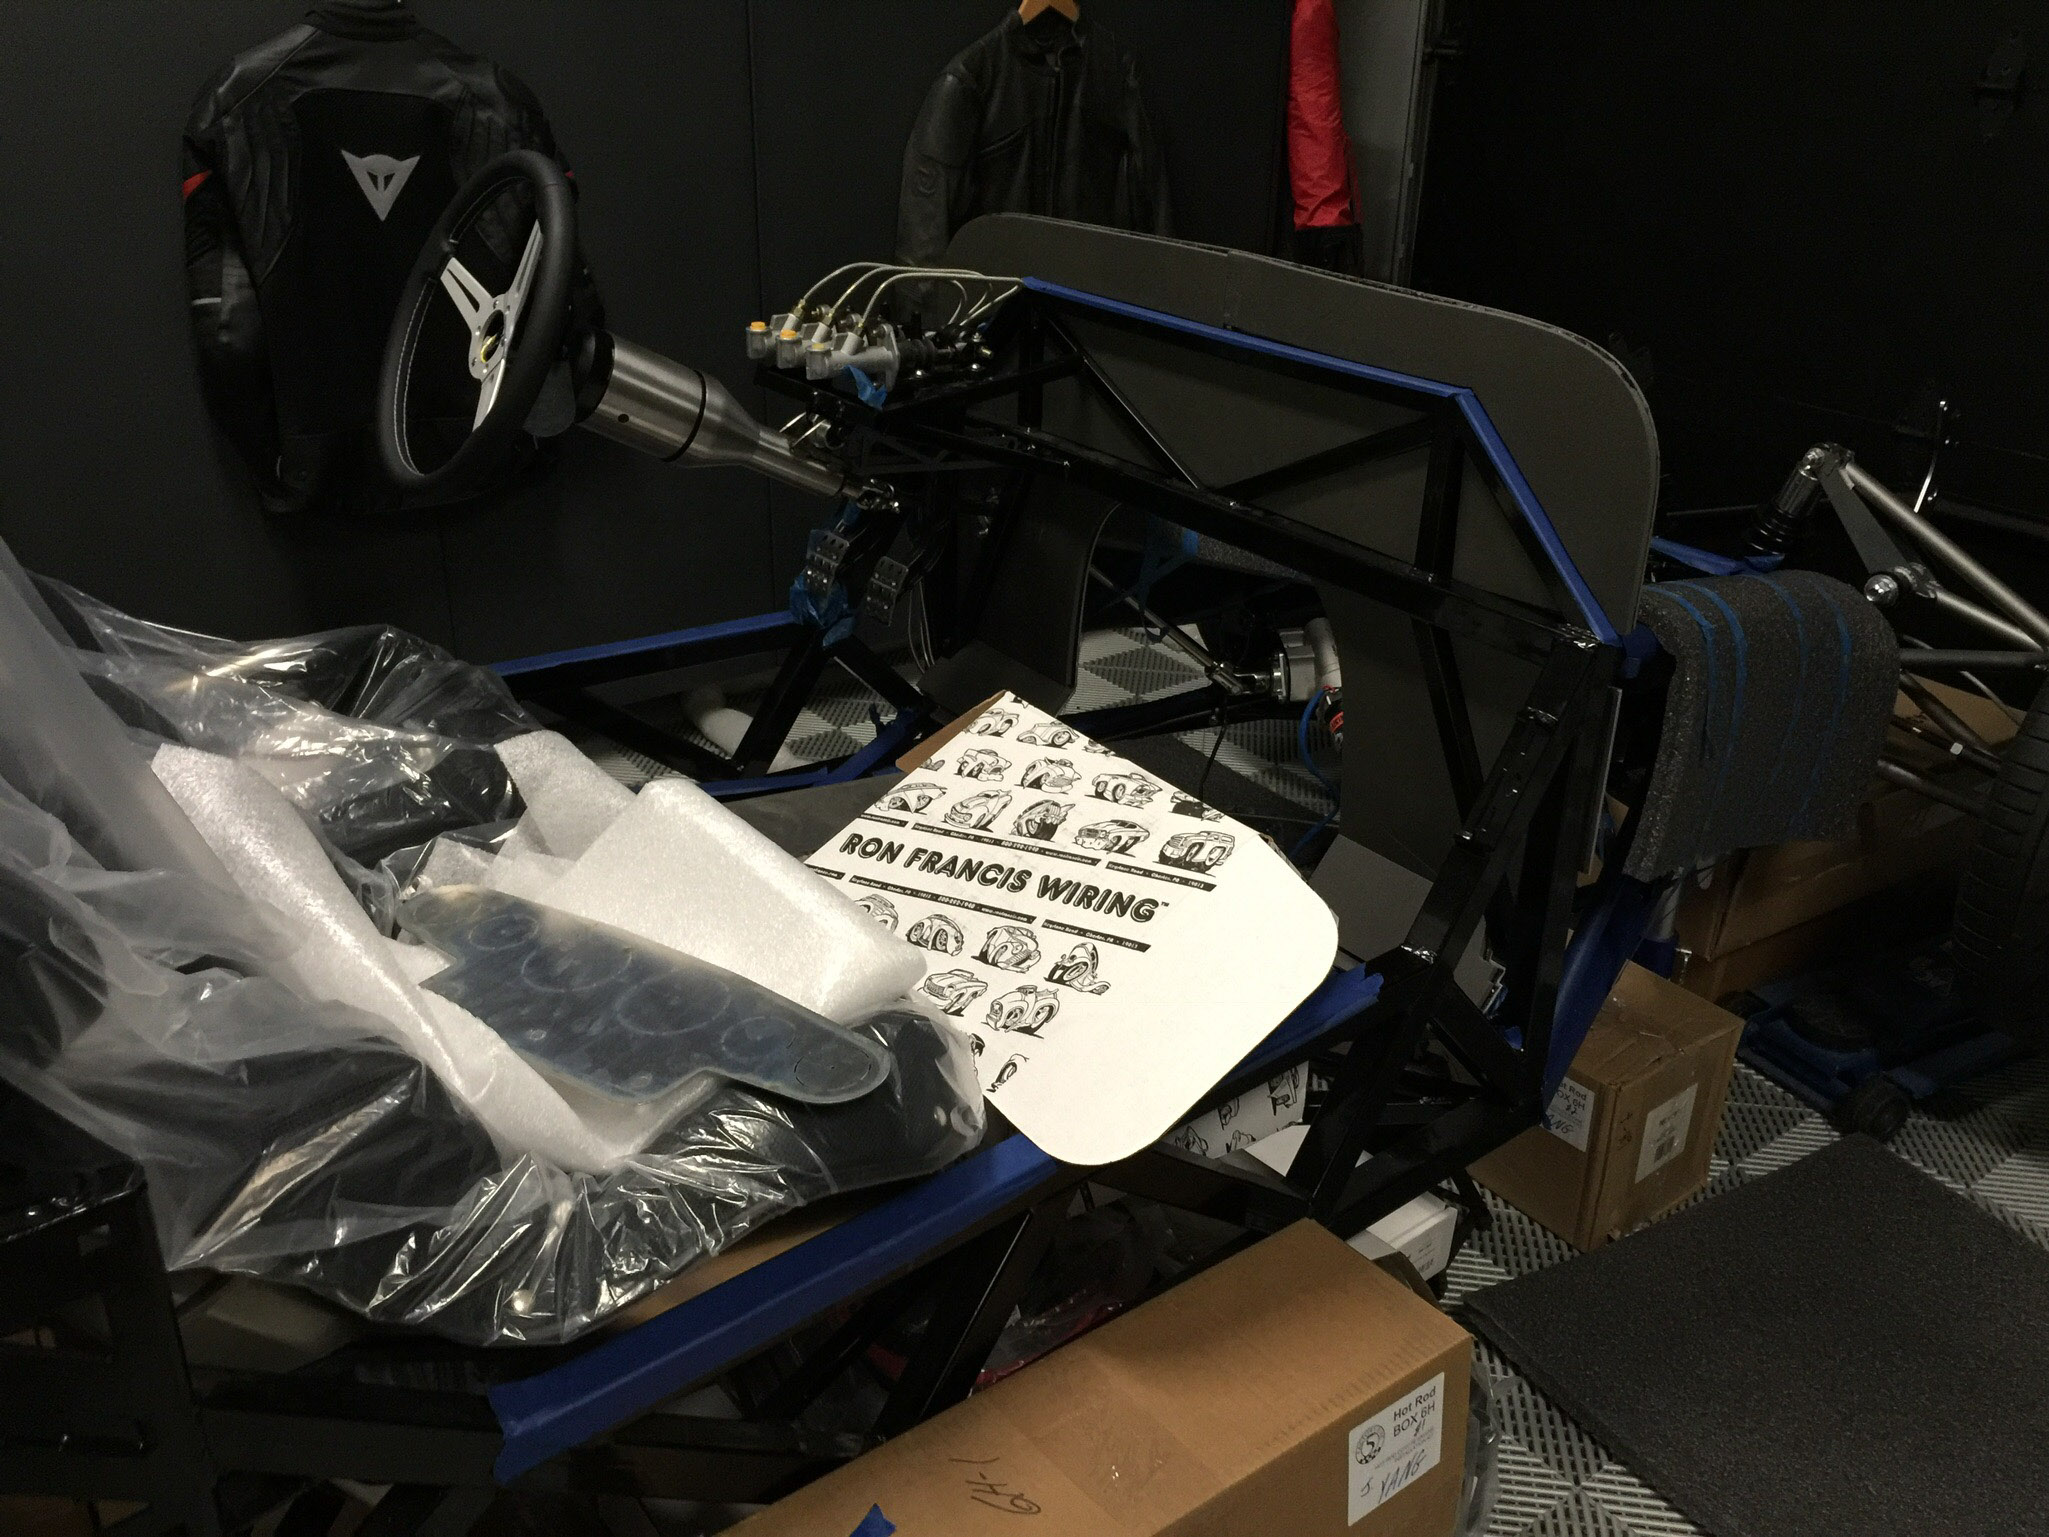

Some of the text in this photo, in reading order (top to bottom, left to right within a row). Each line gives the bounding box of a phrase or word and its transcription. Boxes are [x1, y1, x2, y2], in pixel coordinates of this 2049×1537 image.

[839, 833, 904, 864] RON
[903, 847, 1032, 893] FRANCIS
[1557, 1090, 1570, 1102] OX
[1569, 1086, 1586, 1100] Rod
[1393, 1386, 1436, 1421] Hot Rod
[1393, 1400, 1436, 1437] BOX 6H
[1378, 1449, 1426, 1504] YANG
